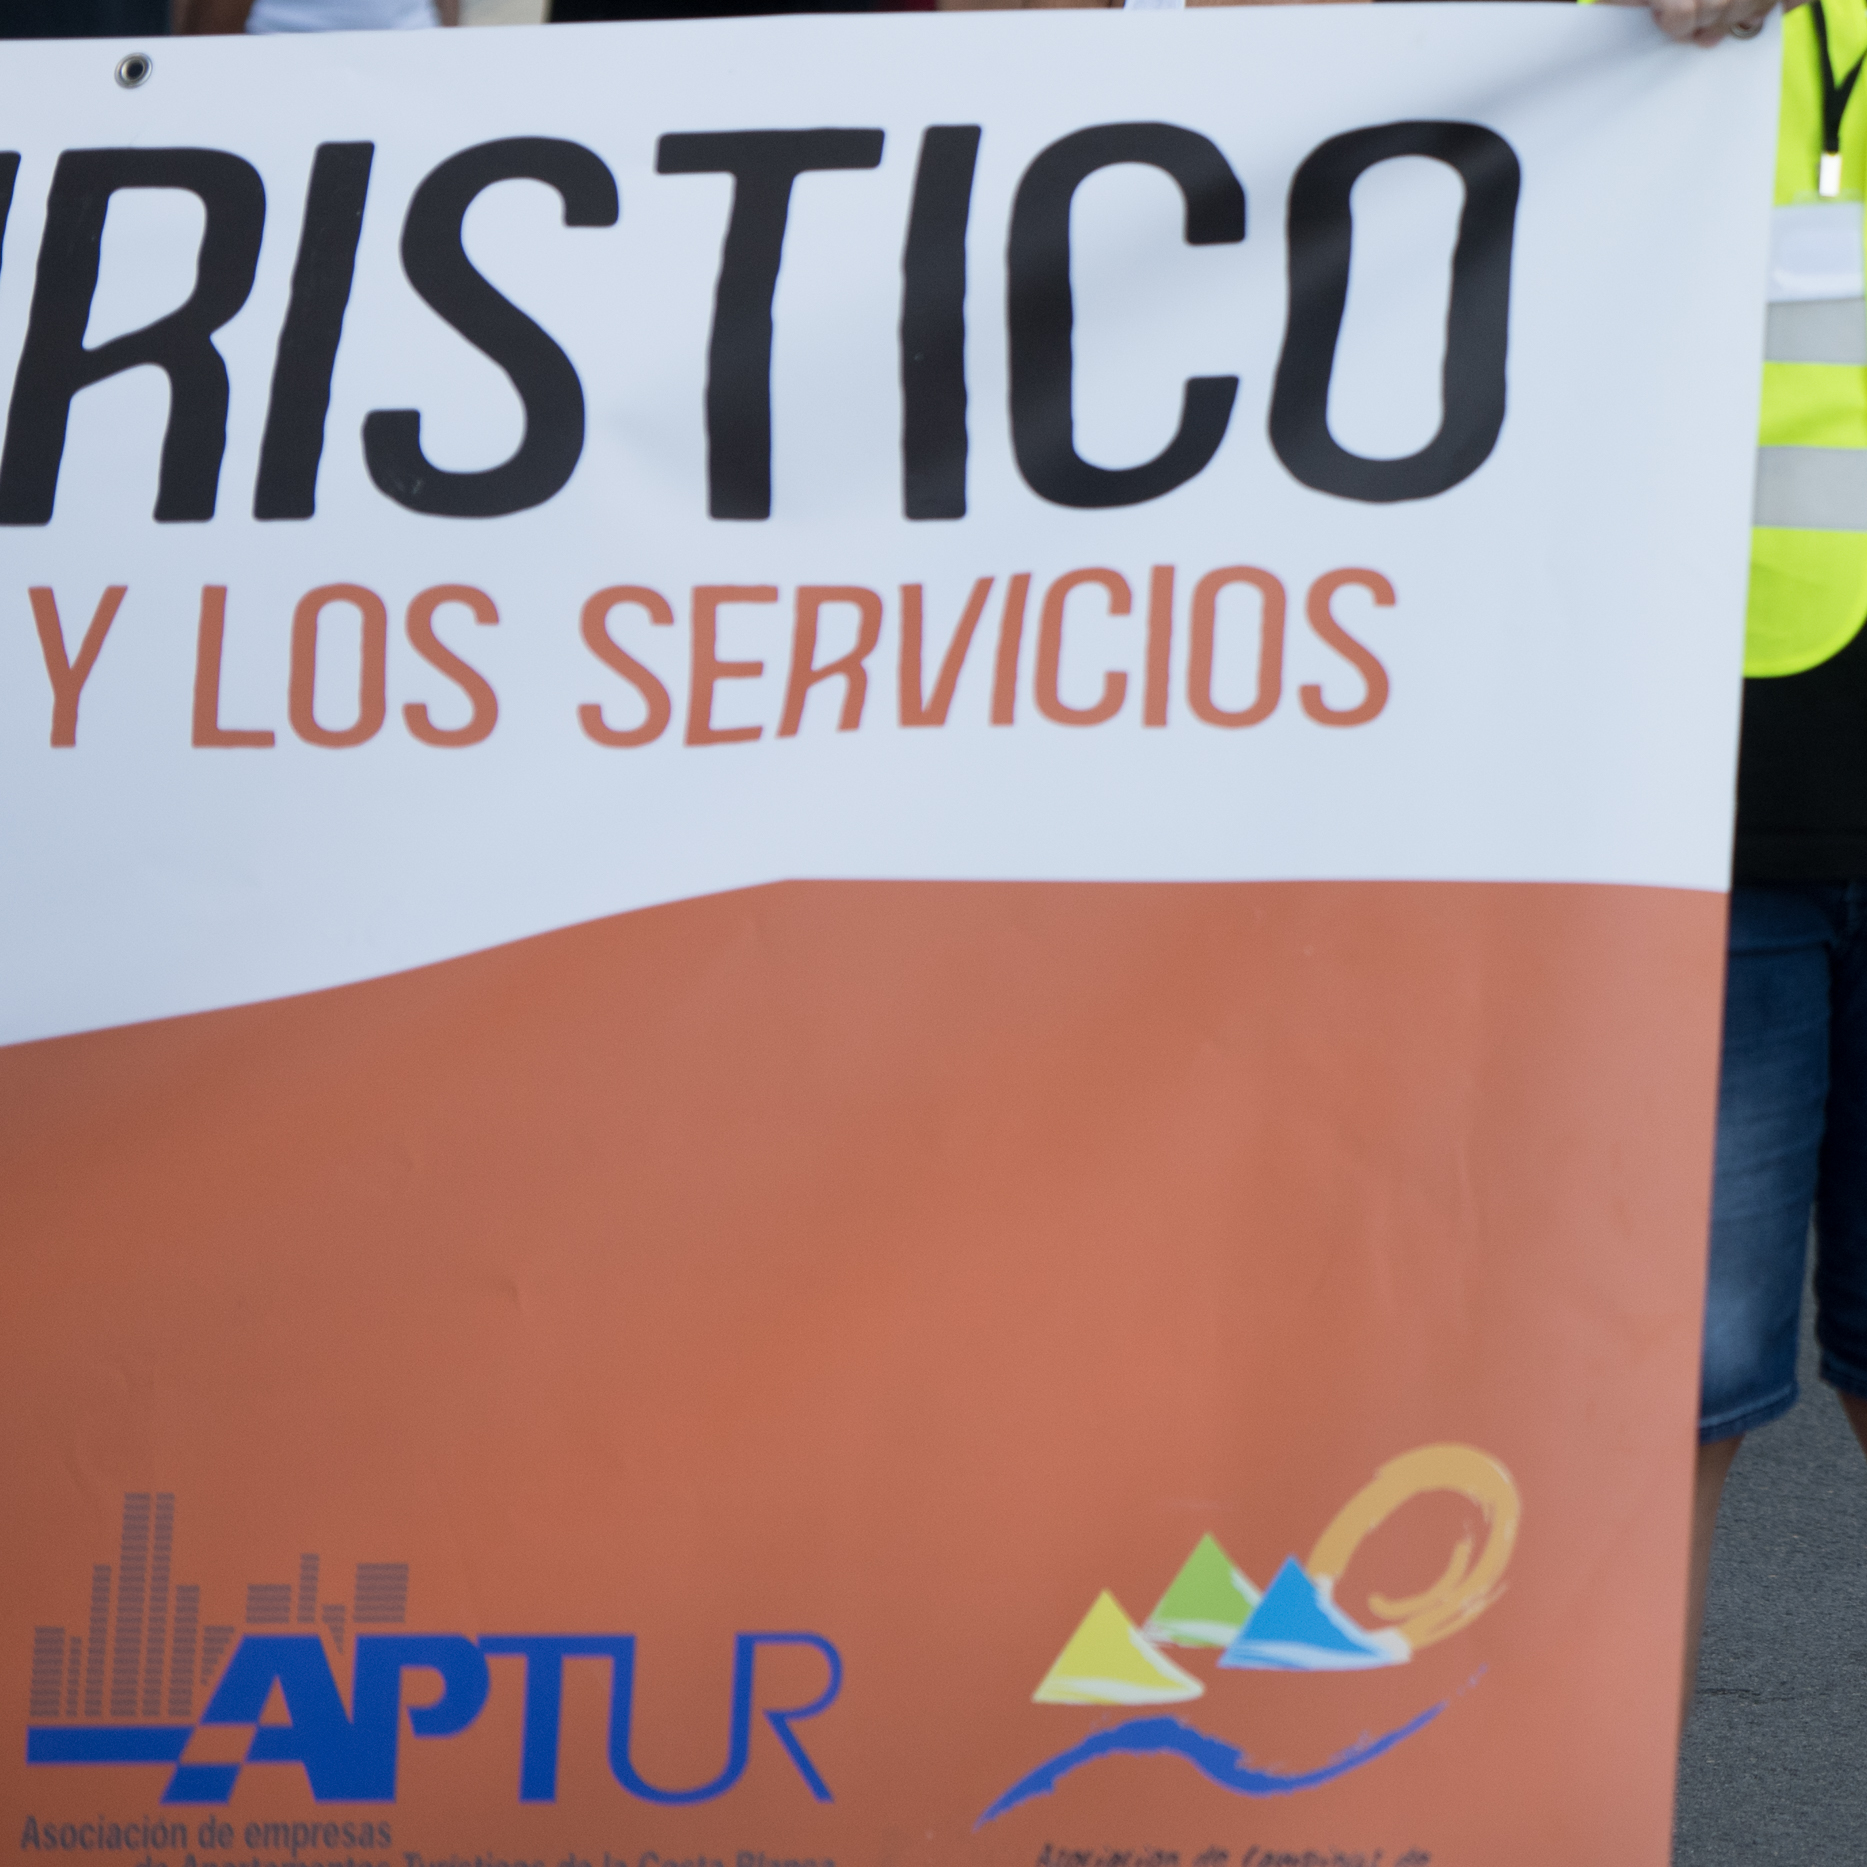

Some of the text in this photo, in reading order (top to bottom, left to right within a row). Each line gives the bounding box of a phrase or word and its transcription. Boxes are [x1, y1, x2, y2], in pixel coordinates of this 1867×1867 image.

[0, 119, 1522, 527] RISTICO
[31, 566, 1396, 747] Y LOS SERVICIOS
[160, 1631, 844, 1805] APTUR
[20, 1814, 393, 1859] Asociación de empresas
